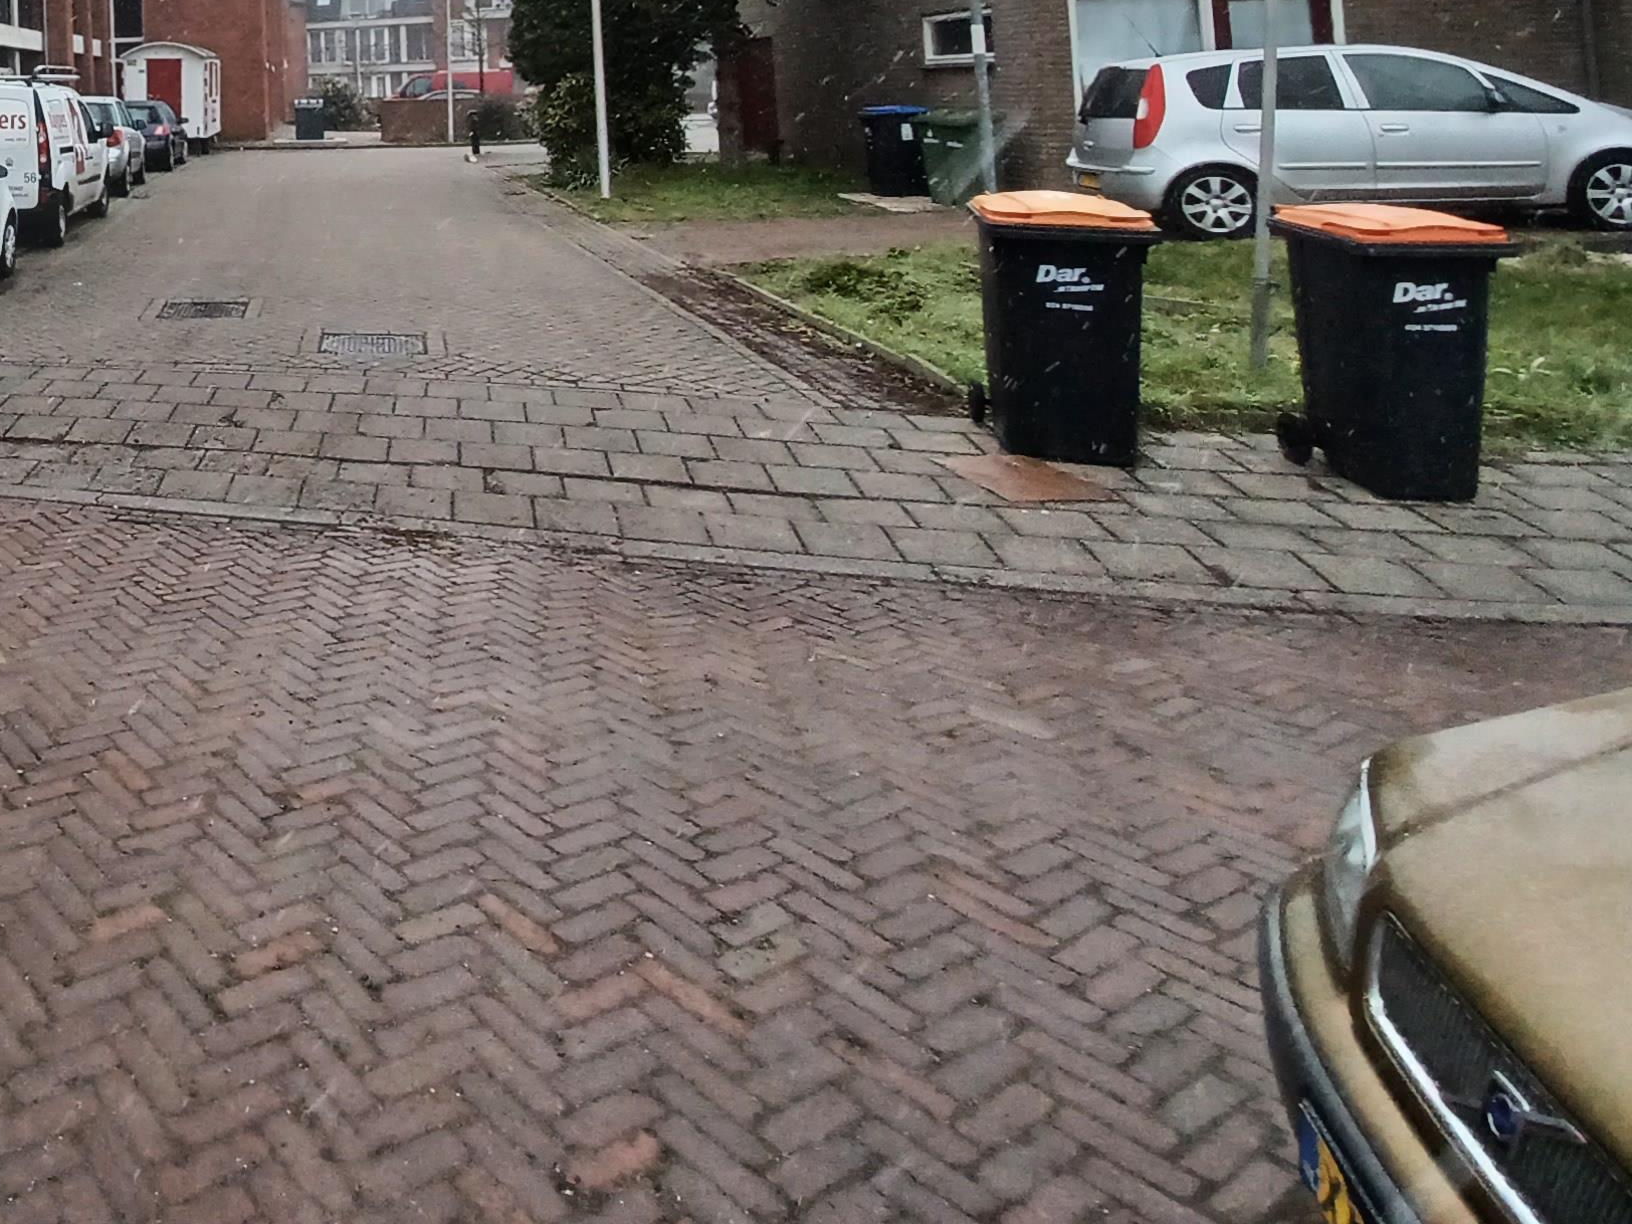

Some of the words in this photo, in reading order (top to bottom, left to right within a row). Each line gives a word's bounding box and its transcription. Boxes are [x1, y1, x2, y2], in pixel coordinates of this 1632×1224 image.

[23, 172, 37, 184] 56
[1035, 264, 1092, 284] Dar.
[1392, 281, 1455, 304] Dar.
